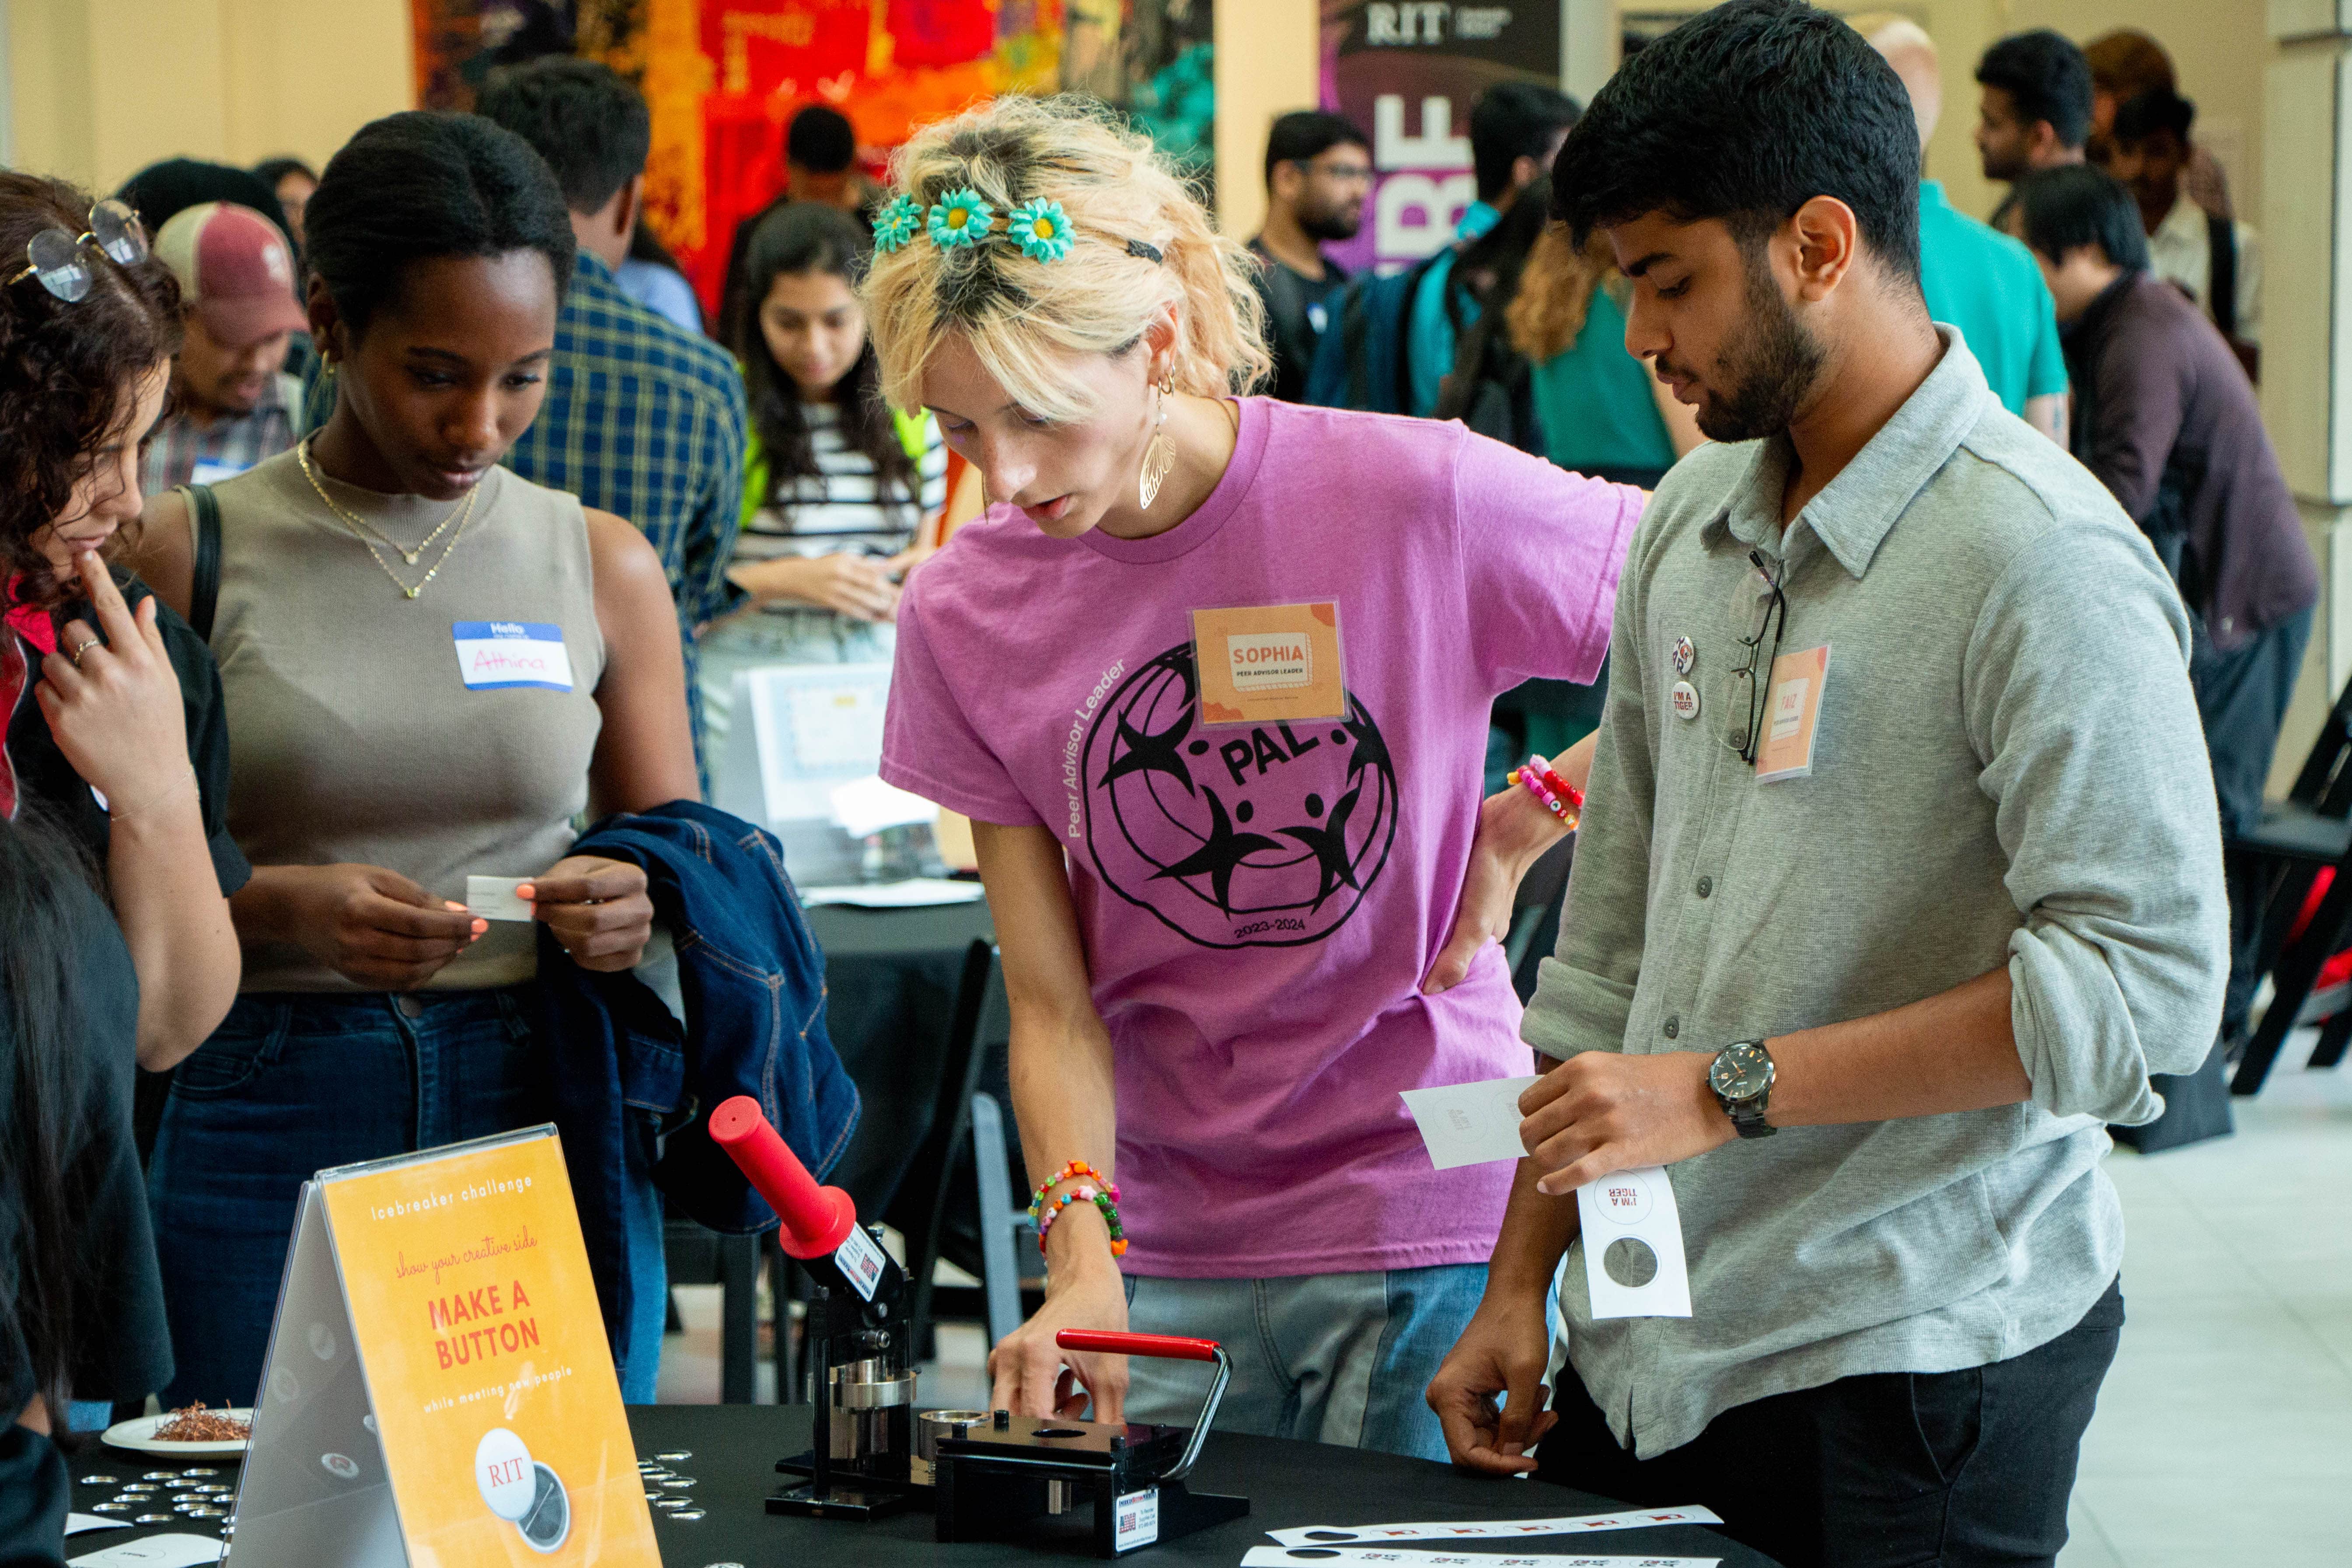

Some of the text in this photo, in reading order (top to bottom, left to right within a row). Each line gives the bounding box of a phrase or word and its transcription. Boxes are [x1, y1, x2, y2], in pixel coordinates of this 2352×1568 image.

[1367, 2, 1450, 45] RIT
[490, 622, 524, 634] Hello
[474, 650, 546, 672] Athina
[1233, 645, 1304, 664] SOPHIA
[1673, 691, 1692, 701] I'M A
[1674, 701, 1694, 711] TIGER
[1062, 659, 1125, 838] Peer Advisor Leader
[1219, 720, 1320, 786] PAL
[1233, 918, 1306, 939] 2023-2024
[371, 1176, 532, 1221] Icebreaker challenge
[1609, 1188, 1637, 1197] TIGER
[1611, 1198, 1637, 1206] I'M A
[395, 1225, 538, 1285] show your creative side
[428, 1280, 531, 1330] MAKE A
[435, 1317, 540, 1370] BUTTON
[423, 1365, 572, 1413] while meeting new people
[488, 1457, 524, 1488] RIT
